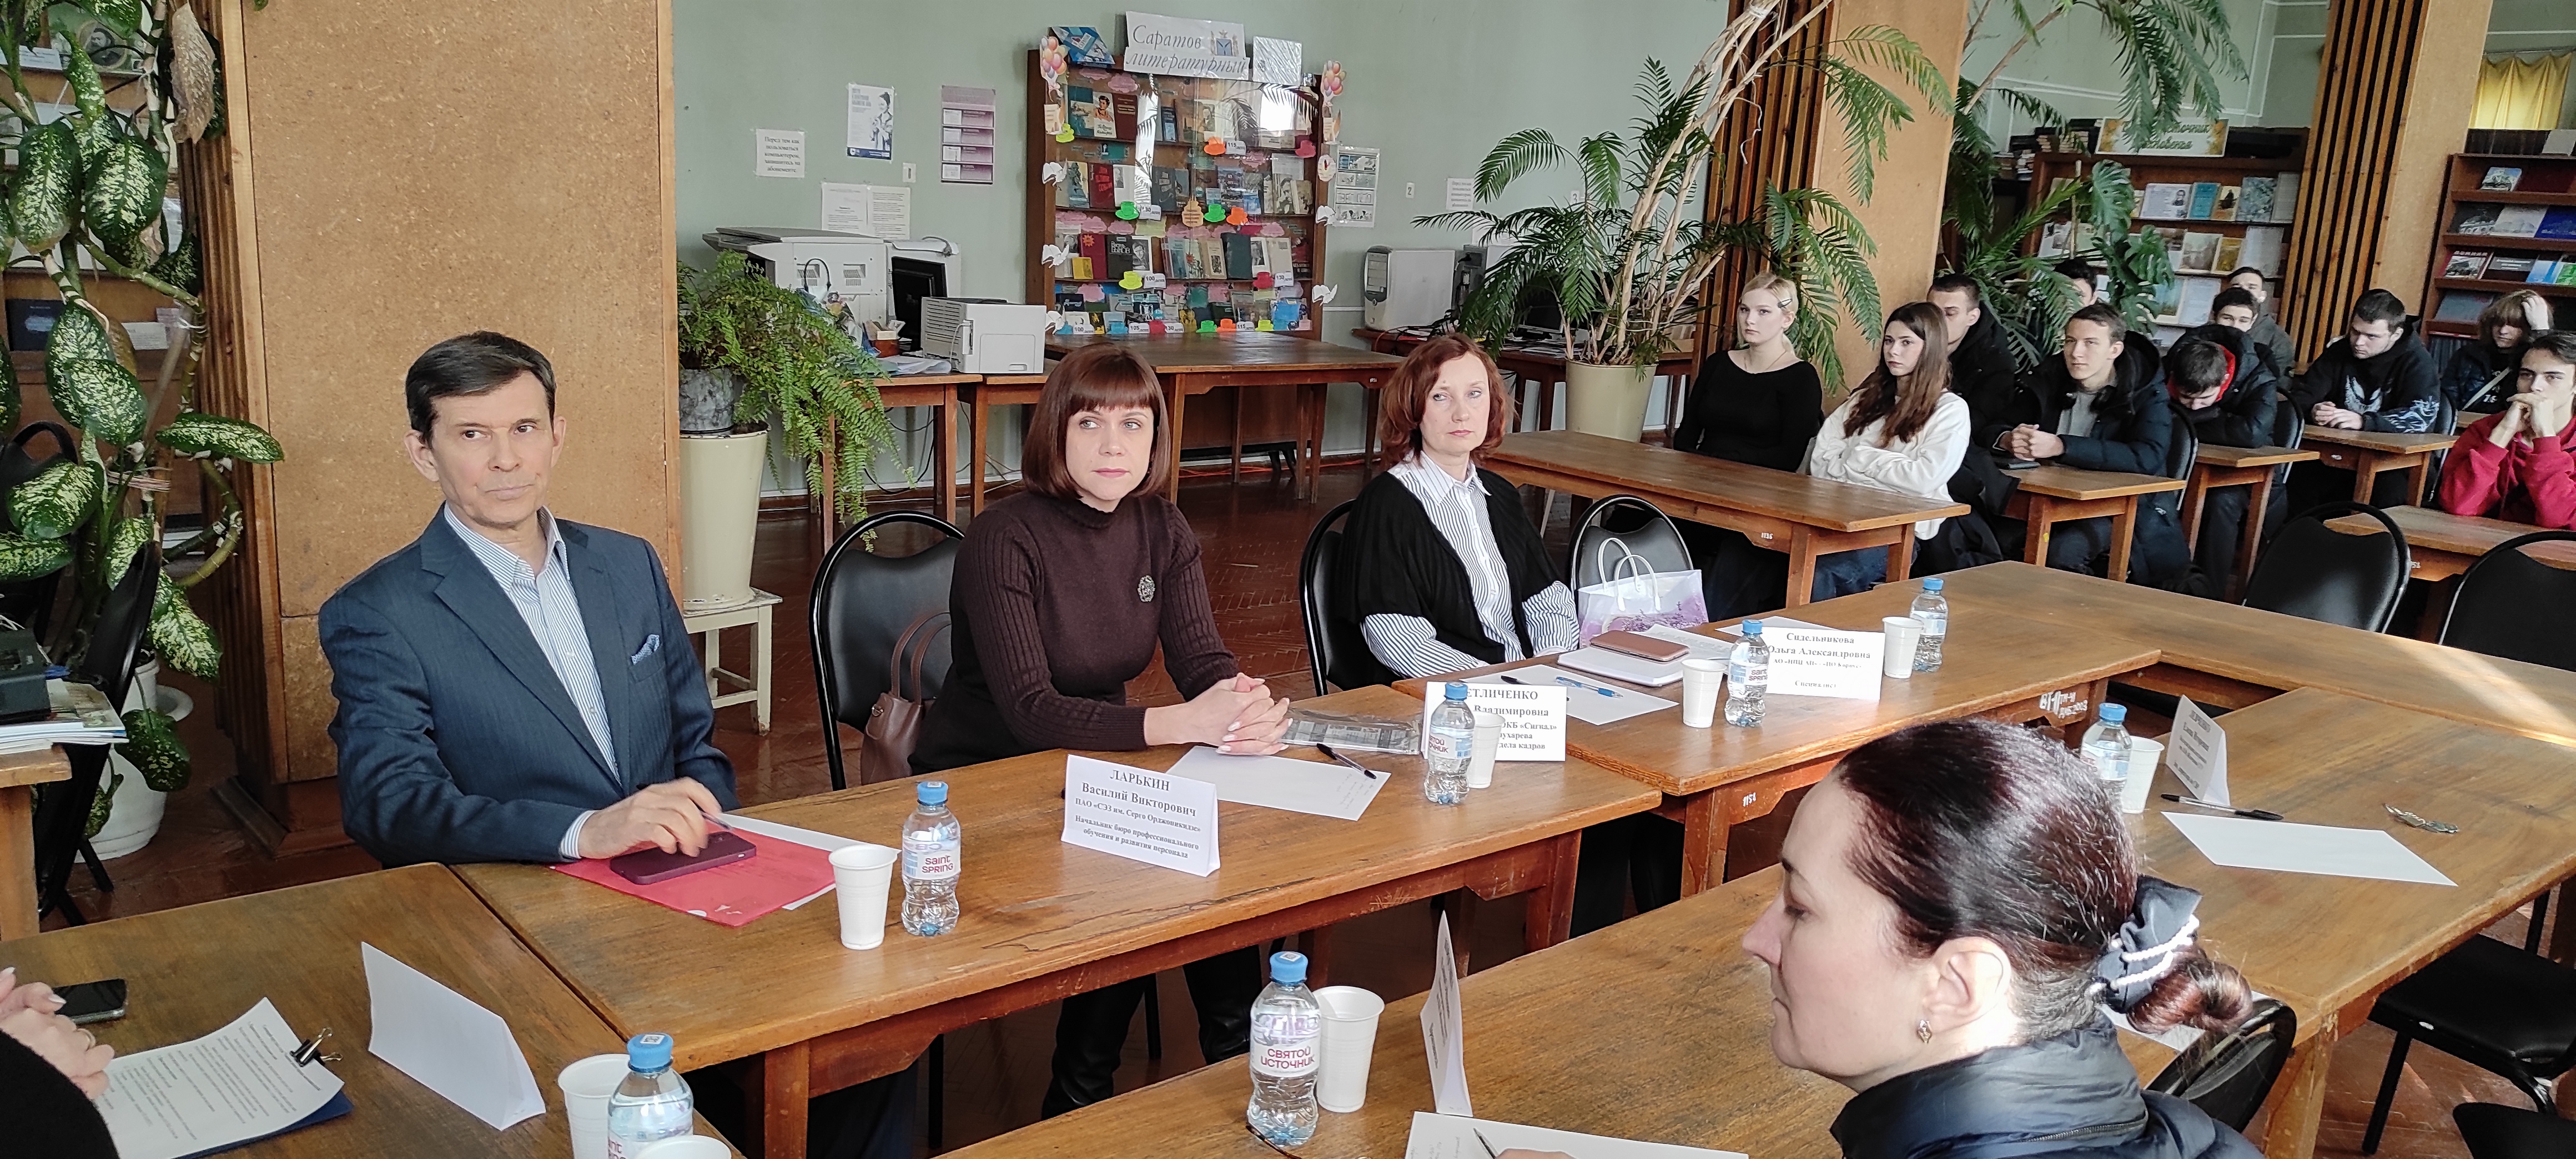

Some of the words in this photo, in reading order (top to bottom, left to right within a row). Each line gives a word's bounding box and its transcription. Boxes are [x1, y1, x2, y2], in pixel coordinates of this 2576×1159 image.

[1133, 24, 1202, 50] Саратов
[1125, 51, 1246, 76] литературный
[1407, 186, 1412, 196] 2
[1786, 632, 1855, 644] Сидельникова
[1768, 645, 1797, 654] Ольга
[1798, 648, 1871, 659] Александровна
[1109, 769, 1170, 792] ЛАРЬКИН
[1081, 782, 1128, 801] Василий
[1131, 792, 1196, 817] Викторович
[1075, 798, 1092, 807] ПАО
[1093, 803, 1112, 812] «СЭЗ
[1126, 809, 1146, 820] Серго
[1147, 814, 1201, 833] Орджоникидзе»
[1075, 815, 1113, 829] Начальник
[1114, 824, 1131, 834] бюро
[1133, 829, 1199, 850] профессионального
[1083, 828, 1114, 841] обучения
[1121, 838, 1152, 850] развития
[1153, 844, 1189, 858] персонала
[1260, 1055, 1316, 1069] ИСТОЧНИК
[1267, 1046, 1311, 1059] СВЯТОЙ
